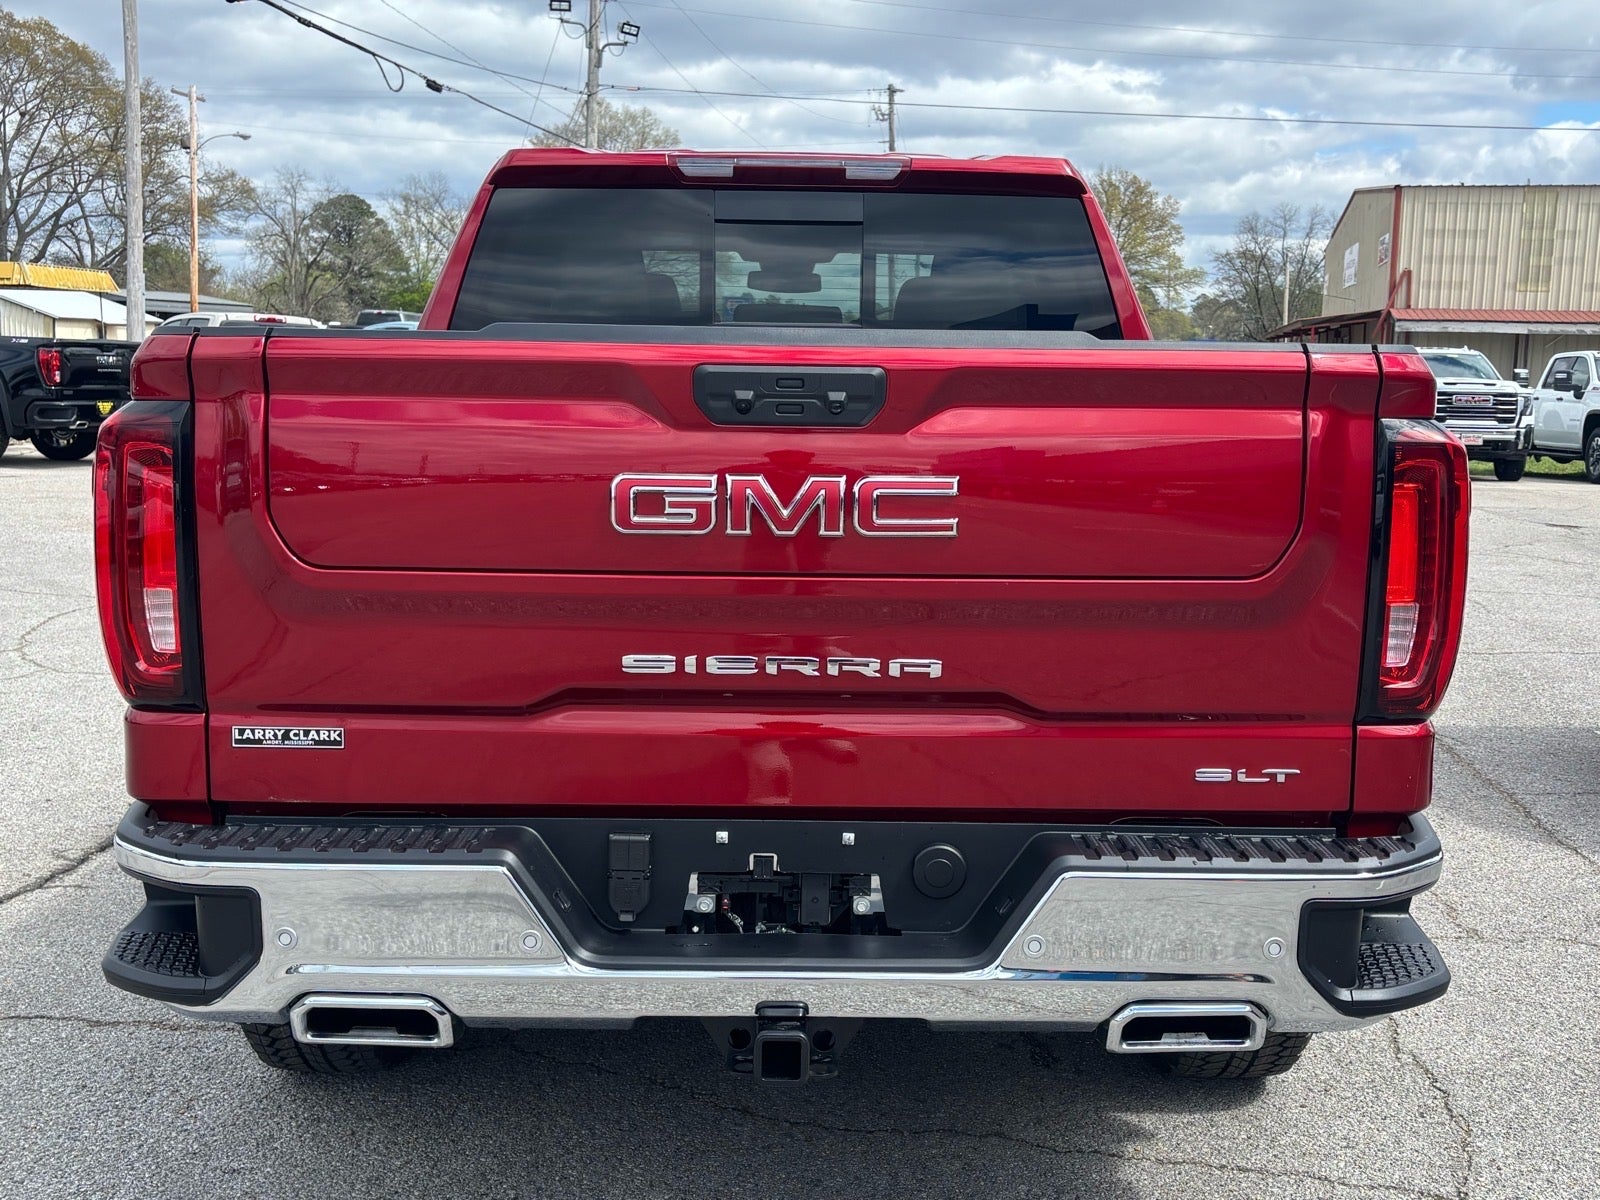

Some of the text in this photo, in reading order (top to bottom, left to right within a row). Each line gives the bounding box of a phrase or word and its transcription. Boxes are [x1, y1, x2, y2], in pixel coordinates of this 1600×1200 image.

[610, 472, 960, 537] GMC
[621, 654, 943, 679] SIERRA
[234, 728, 341, 741] LARRY CLARK
[1195, 768, 1301, 783] SLT
